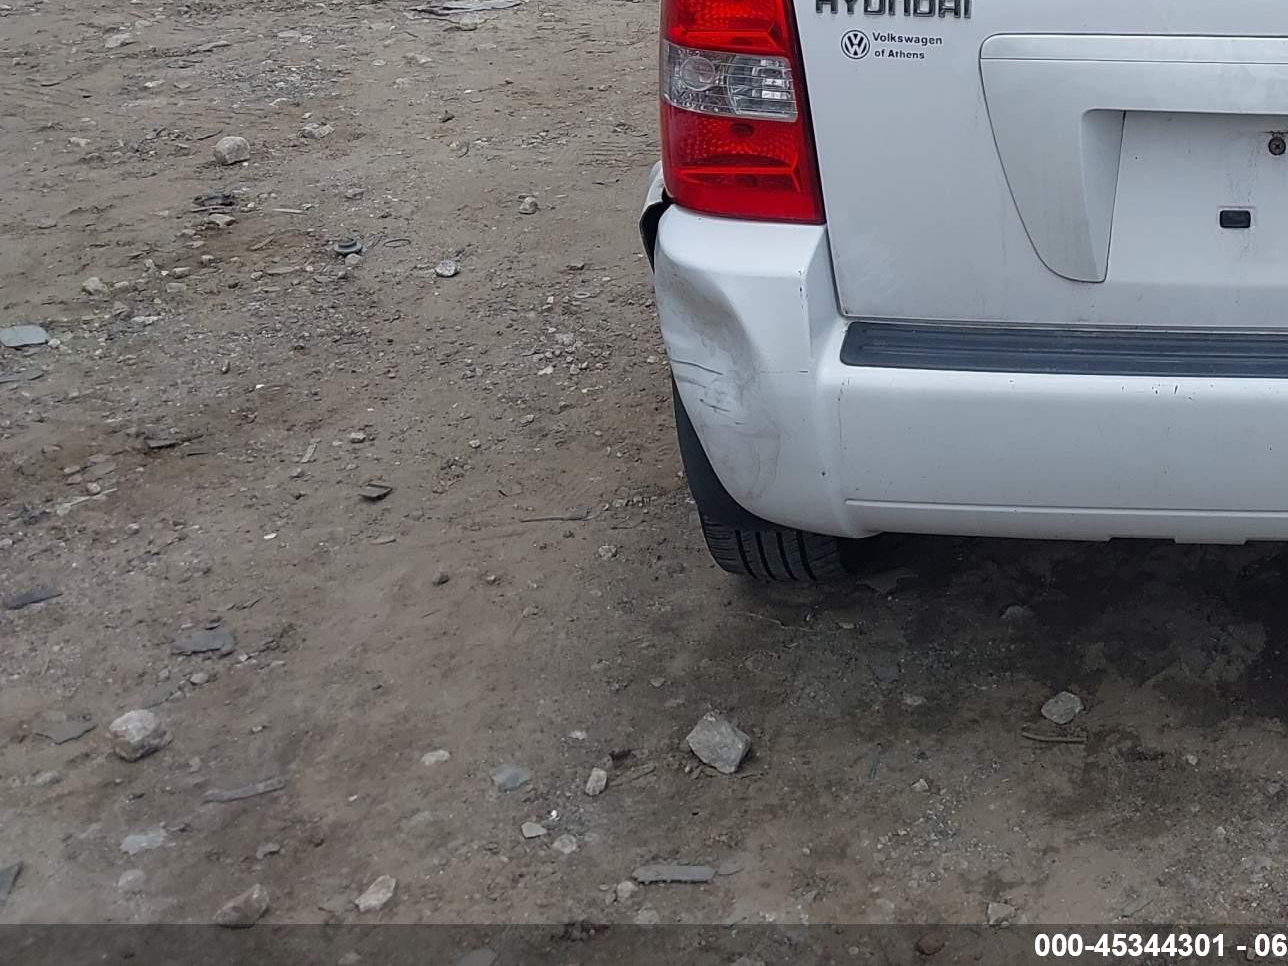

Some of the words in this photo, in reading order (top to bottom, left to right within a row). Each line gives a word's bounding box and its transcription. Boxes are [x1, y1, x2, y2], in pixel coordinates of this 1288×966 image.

[872, 32, 943, 46] Volkswagen
[874, 49, 885, 58] of
[887, 49, 925, 59] Athens
